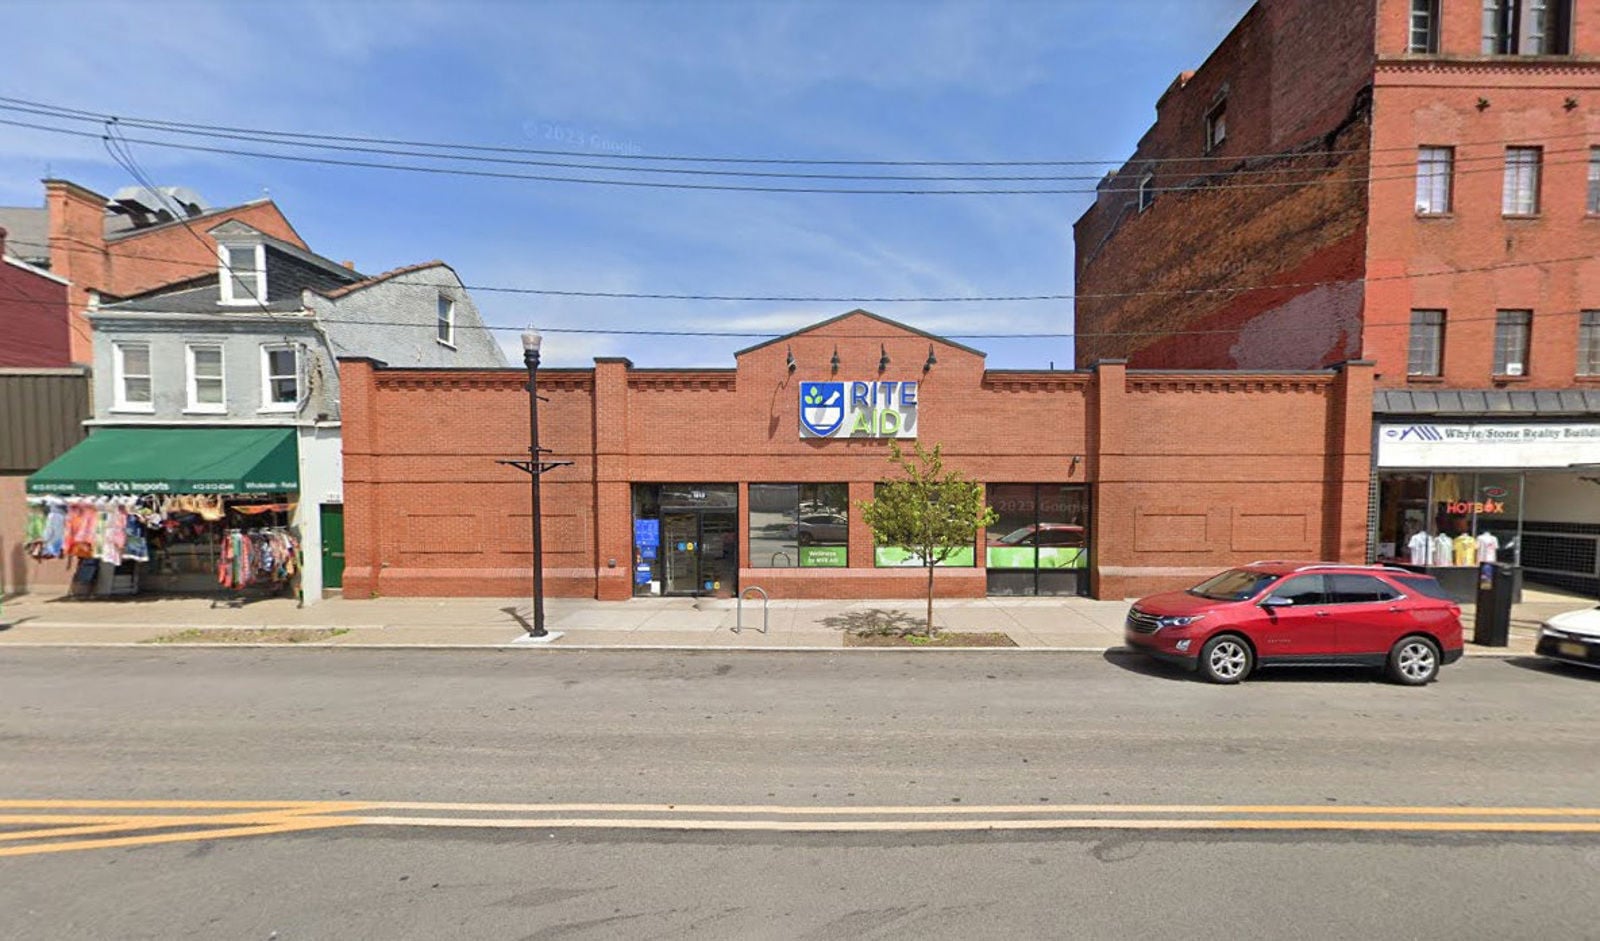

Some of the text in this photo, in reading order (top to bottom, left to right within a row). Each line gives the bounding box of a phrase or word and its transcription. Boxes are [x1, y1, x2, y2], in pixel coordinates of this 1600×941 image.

[852, 381, 917, 405] RITE
[853, 408, 901, 434] AID
[1523, 427, 1561, 440] Realty
[97, 481, 170, 492] Nick's Imports
[1446, 498, 1505, 514] HOTBOX
